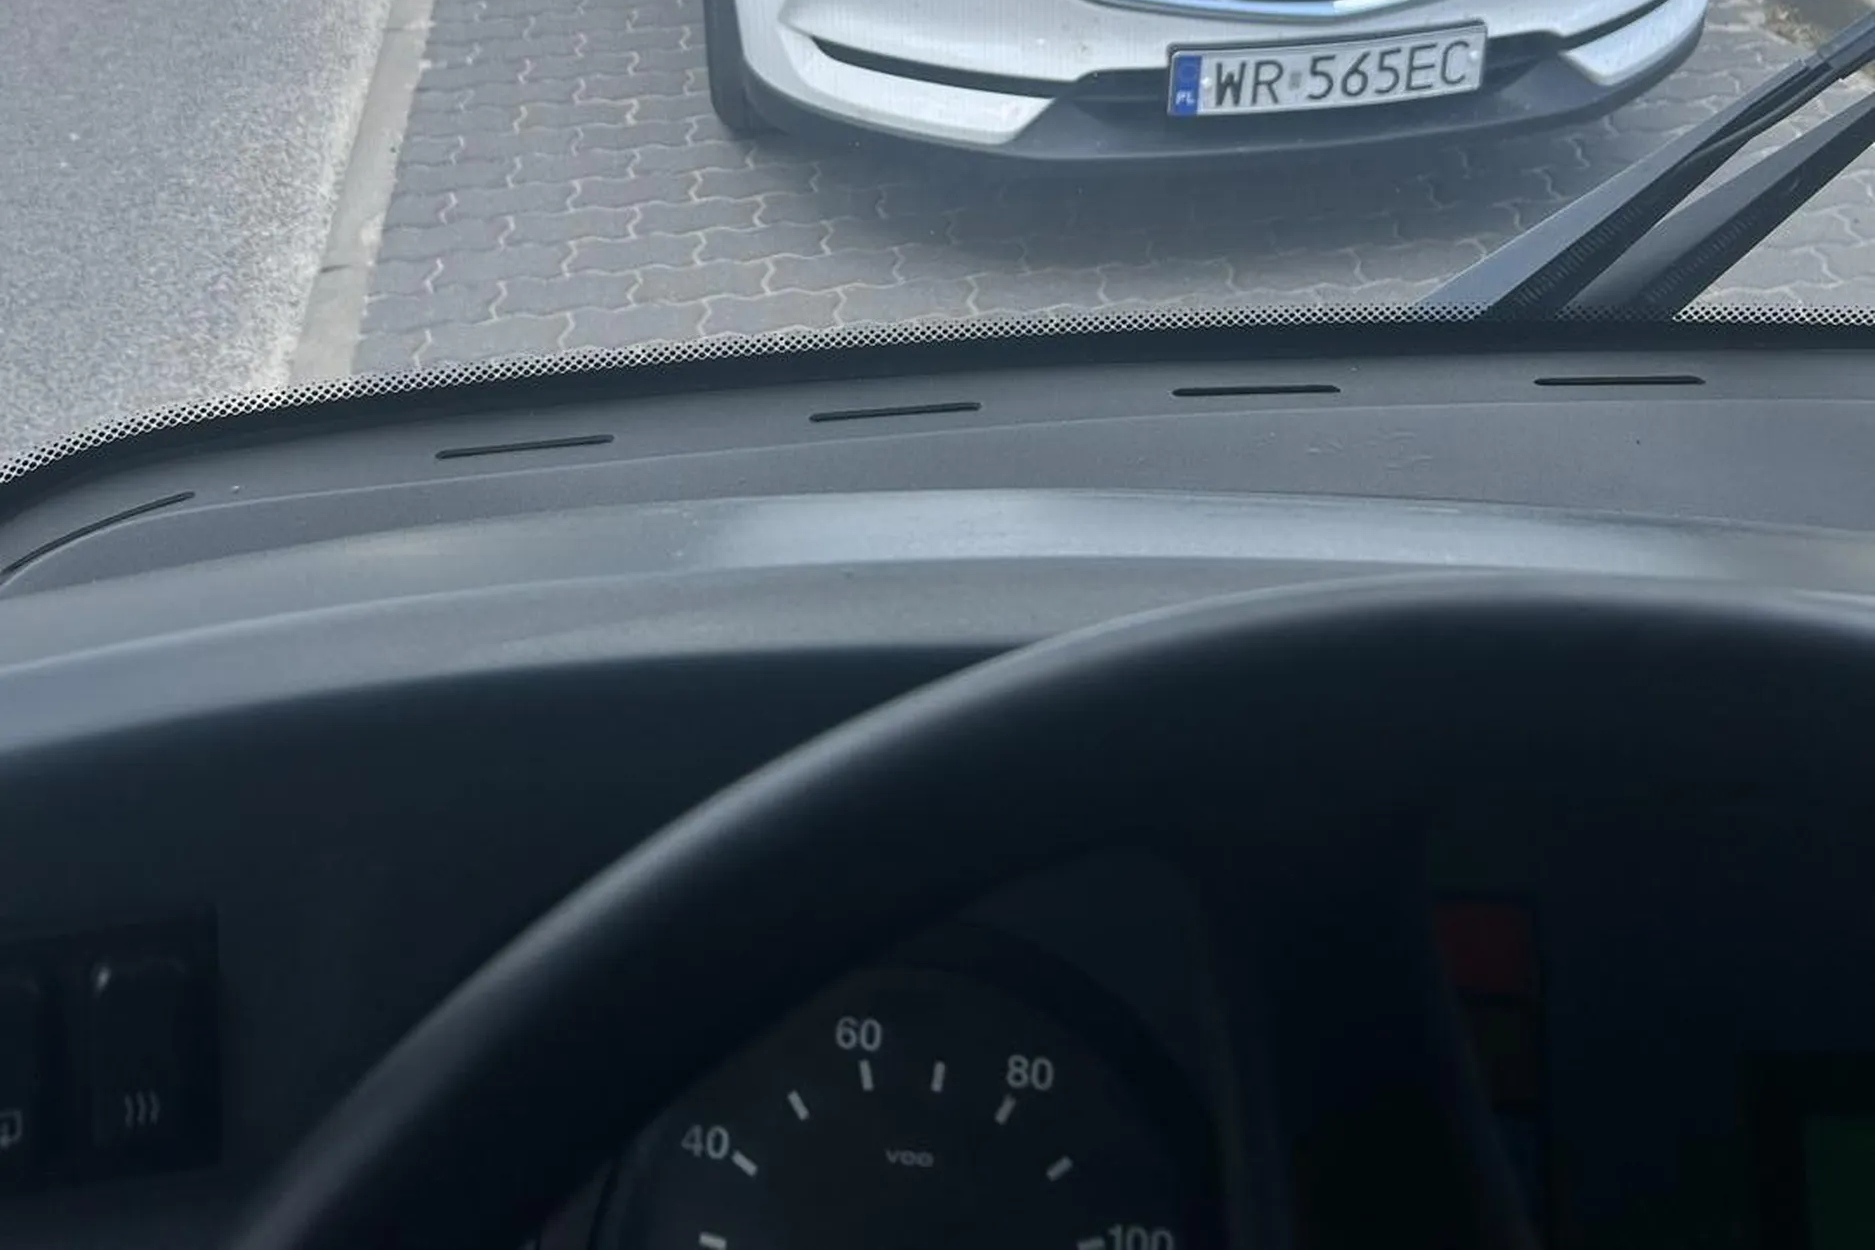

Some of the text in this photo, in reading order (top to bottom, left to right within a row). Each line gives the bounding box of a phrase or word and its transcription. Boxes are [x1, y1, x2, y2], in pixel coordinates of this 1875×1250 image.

[1215, 41, 1470, 107] WR 565EC
[1176, 90, 1196, 107] PL
[835, 1017, 882, 1051] 60
[1006, 1055, 1054, 1091] 80
[681, 1124, 730, 1160] 40
[1107, 1223, 1176, 1250] 100
